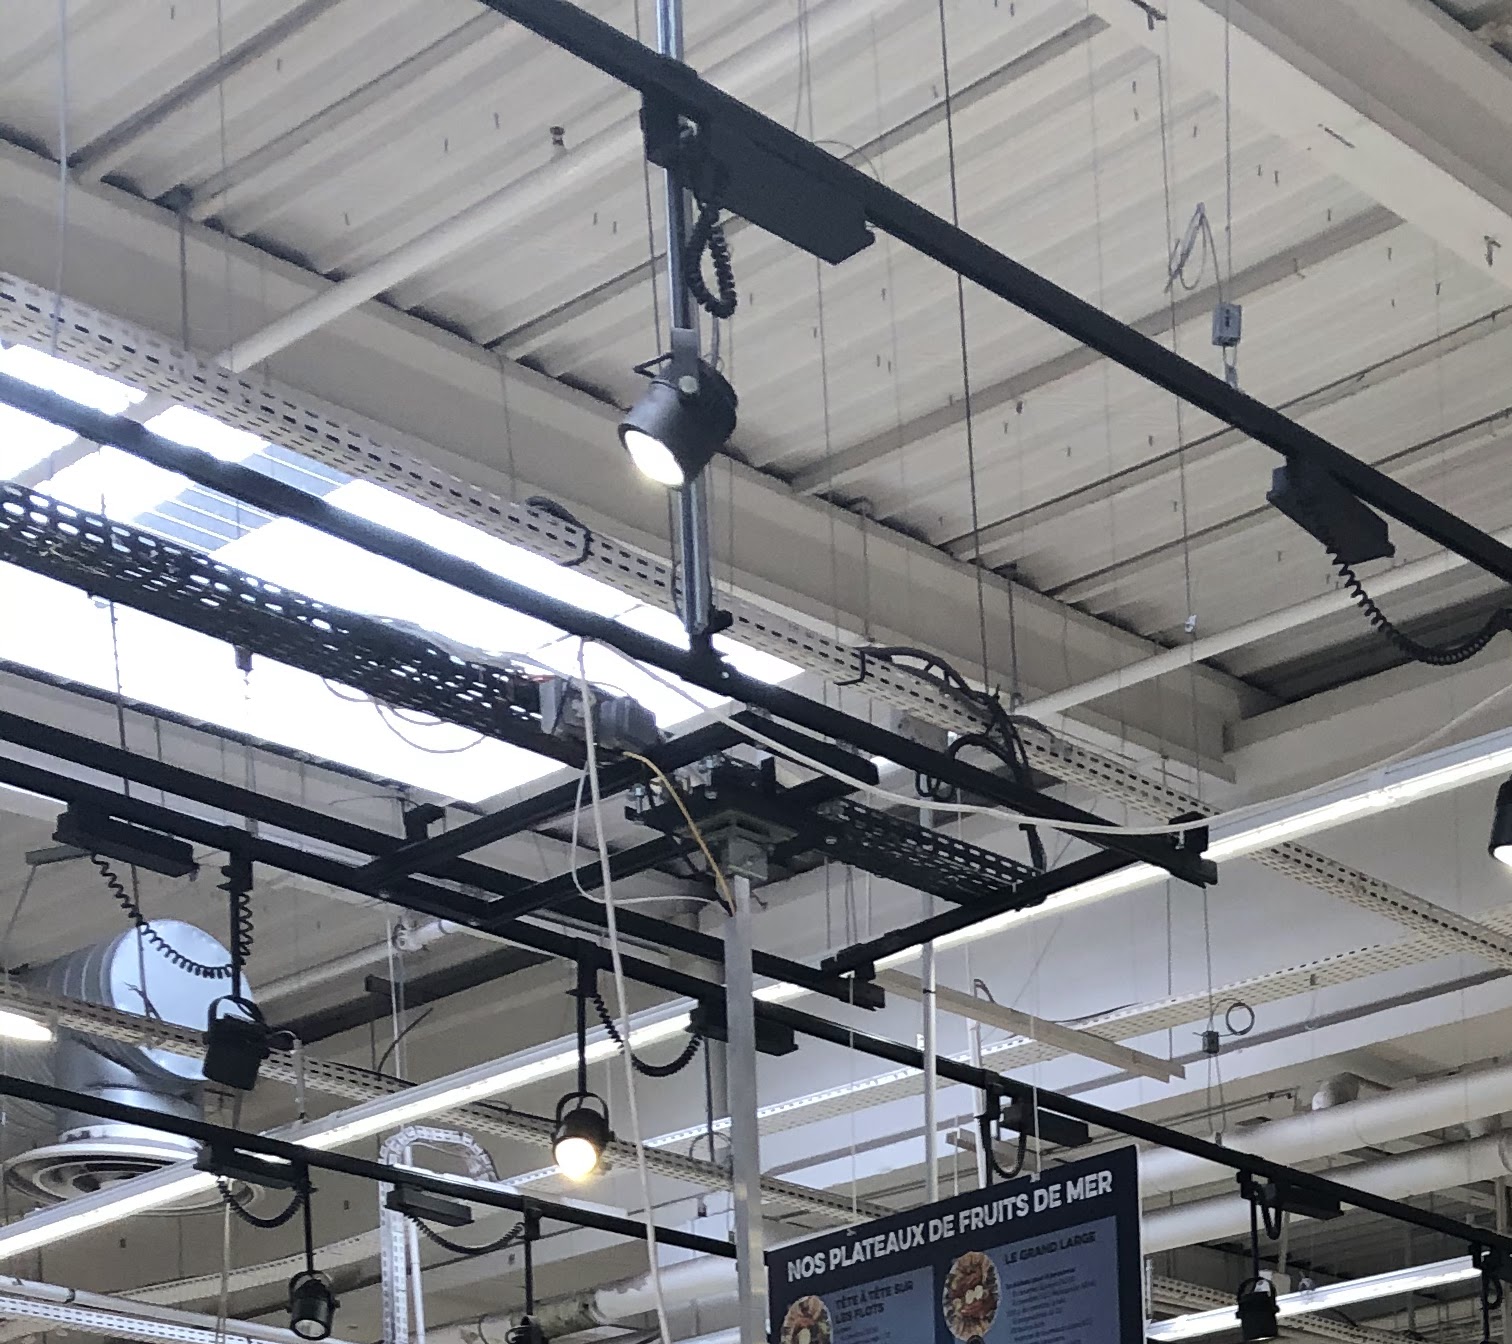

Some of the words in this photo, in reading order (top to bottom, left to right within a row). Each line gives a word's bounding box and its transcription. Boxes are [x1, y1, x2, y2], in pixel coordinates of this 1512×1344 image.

[787, 1252, 826, 1282] NOS
[829, 1223, 925, 1271] PLATEAUX
[928, 1214, 955, 1242] DE
[959, 1193, 1030, 1233] FRUITS
[1033, 1183, 1062, 1213] DE
[1066, 1170, 1112, 1203] MER
[1019, 1242, 1057, 1261] GRAND
[1060, 1231, 1096, 1248] LARGE
